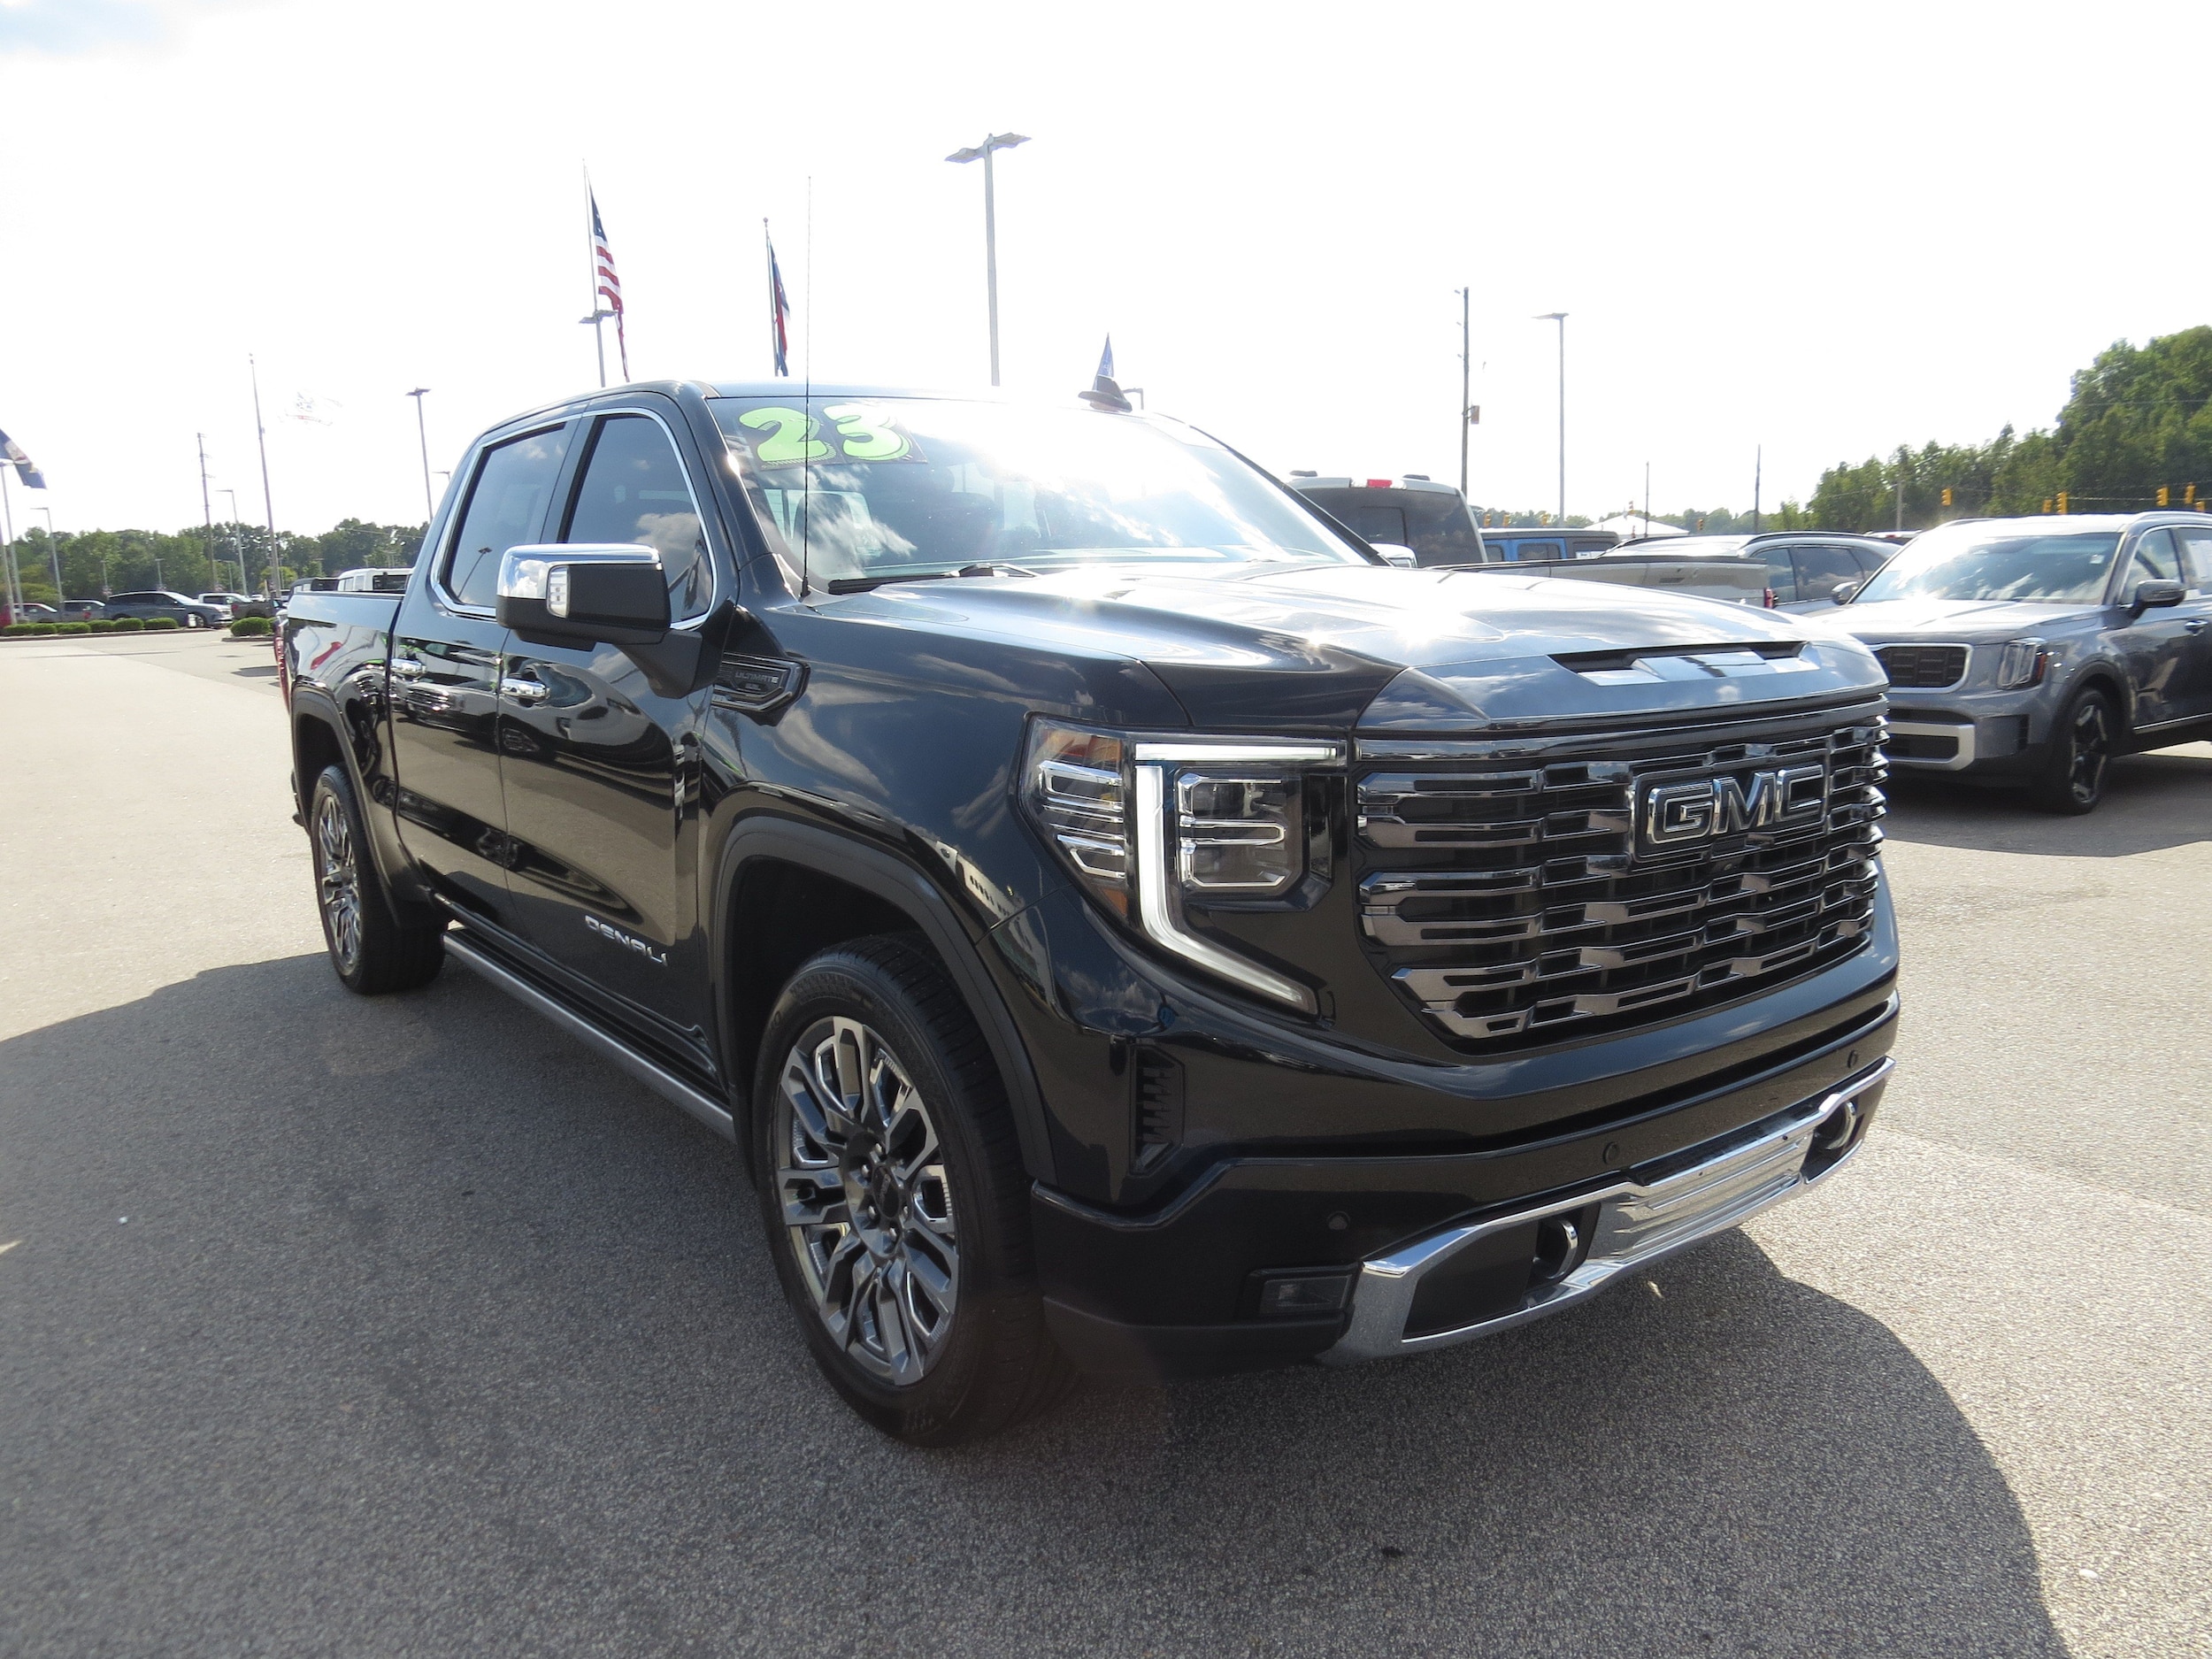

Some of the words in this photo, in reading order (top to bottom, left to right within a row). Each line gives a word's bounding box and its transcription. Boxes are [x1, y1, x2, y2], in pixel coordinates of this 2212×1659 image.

[739, 404, 911, 463] 23
[735, 672, 779, 683] ULTIMATE
[1647, 764, 1824, 844] GMC
[585, 914, 668, 966] DENALI
